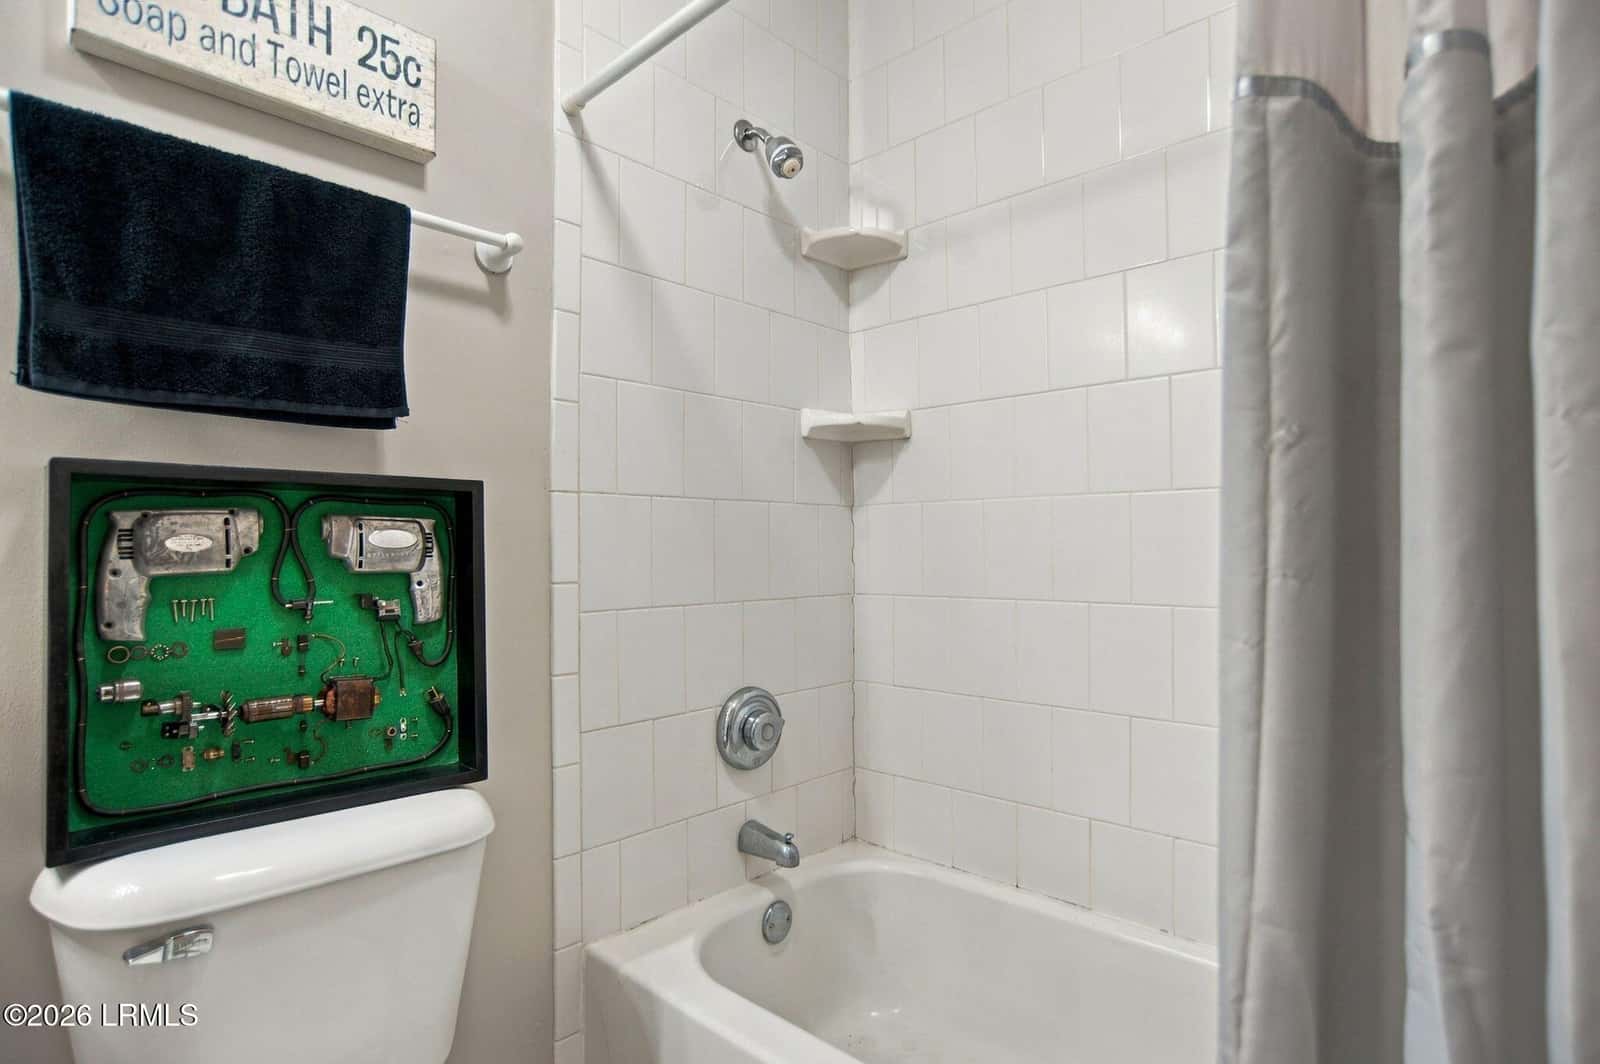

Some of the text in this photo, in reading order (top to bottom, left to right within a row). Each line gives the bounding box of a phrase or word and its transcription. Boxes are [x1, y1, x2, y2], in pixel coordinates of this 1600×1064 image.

[199, 24, 256, 68] and
[266, 39, 347, 100] Towel
[356, 83, 421, 129] extra
